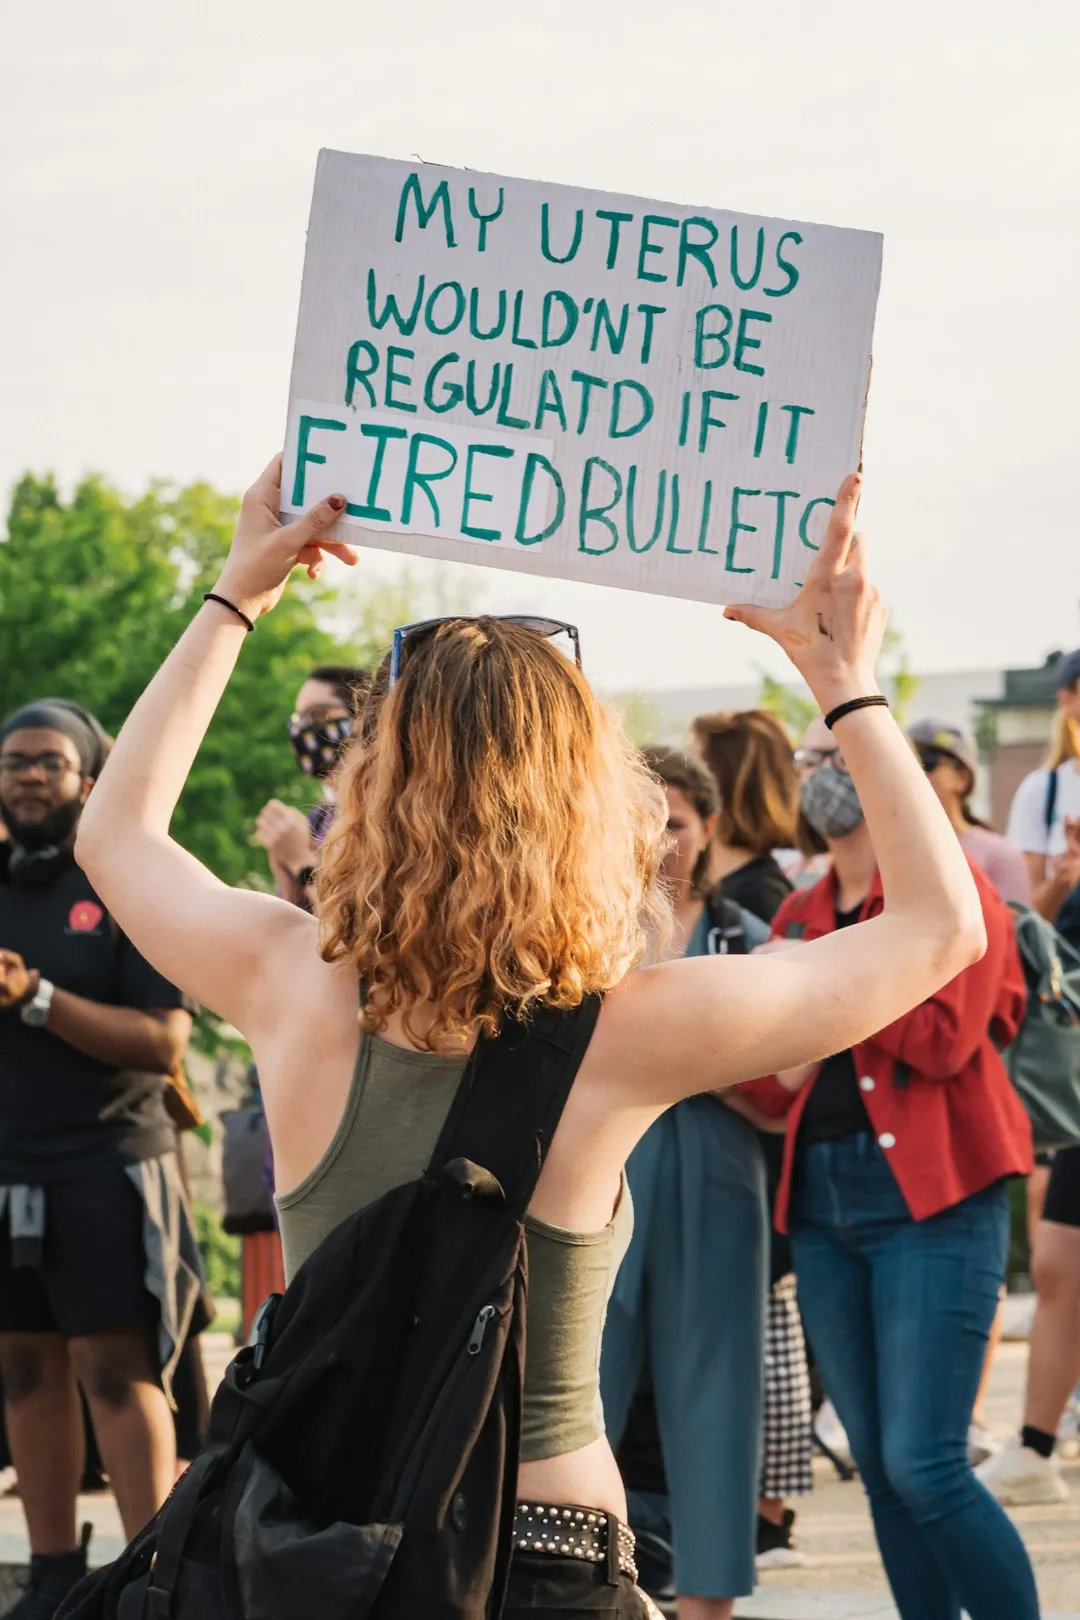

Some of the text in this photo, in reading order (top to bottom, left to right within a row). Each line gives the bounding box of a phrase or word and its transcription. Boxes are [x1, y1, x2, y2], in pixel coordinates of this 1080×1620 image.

[395, 172, 803, 298] MY UTERUS
[367, 268, 772, 376] WOULD'NT BE
[345, 339, 815, 464] REGULATD IF IT
[291, 415, 565, 546] FIRED
